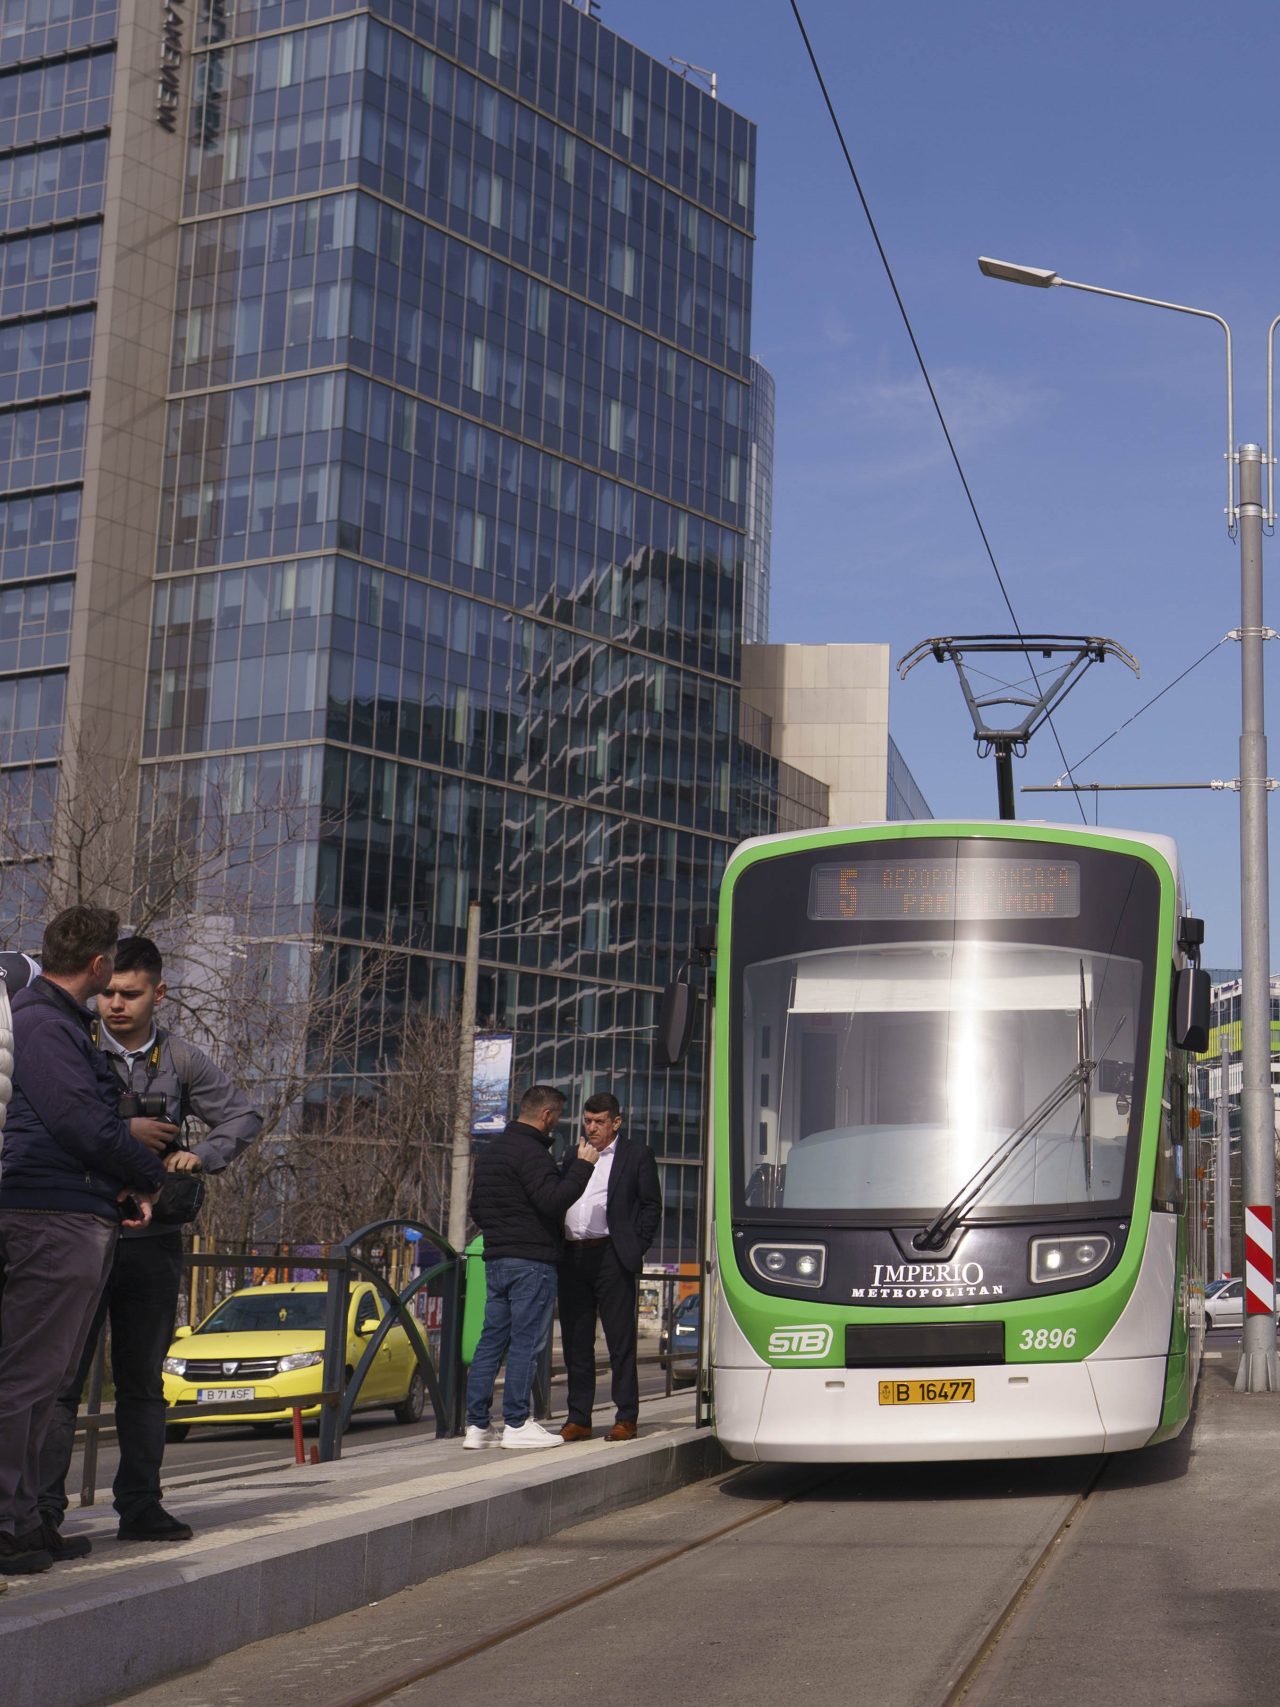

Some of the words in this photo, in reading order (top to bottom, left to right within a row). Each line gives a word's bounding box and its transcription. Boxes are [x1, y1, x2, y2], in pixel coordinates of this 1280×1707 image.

[838, 868, 859, 918] 5
[871, 1262, 984, 1287] IMPERIO
[851, 1284, 1004, 1299] METROPOLITAN
[768, 1328, 829, 1355] STB
[1018, 1327, 1078, 1351] 3896
[207, 1390, 215, 1400] B
[217, 1390, 228, 1400] 71
[896, 1383, 911, 1402] B
[919, 1381, 972, 1402] 16477
